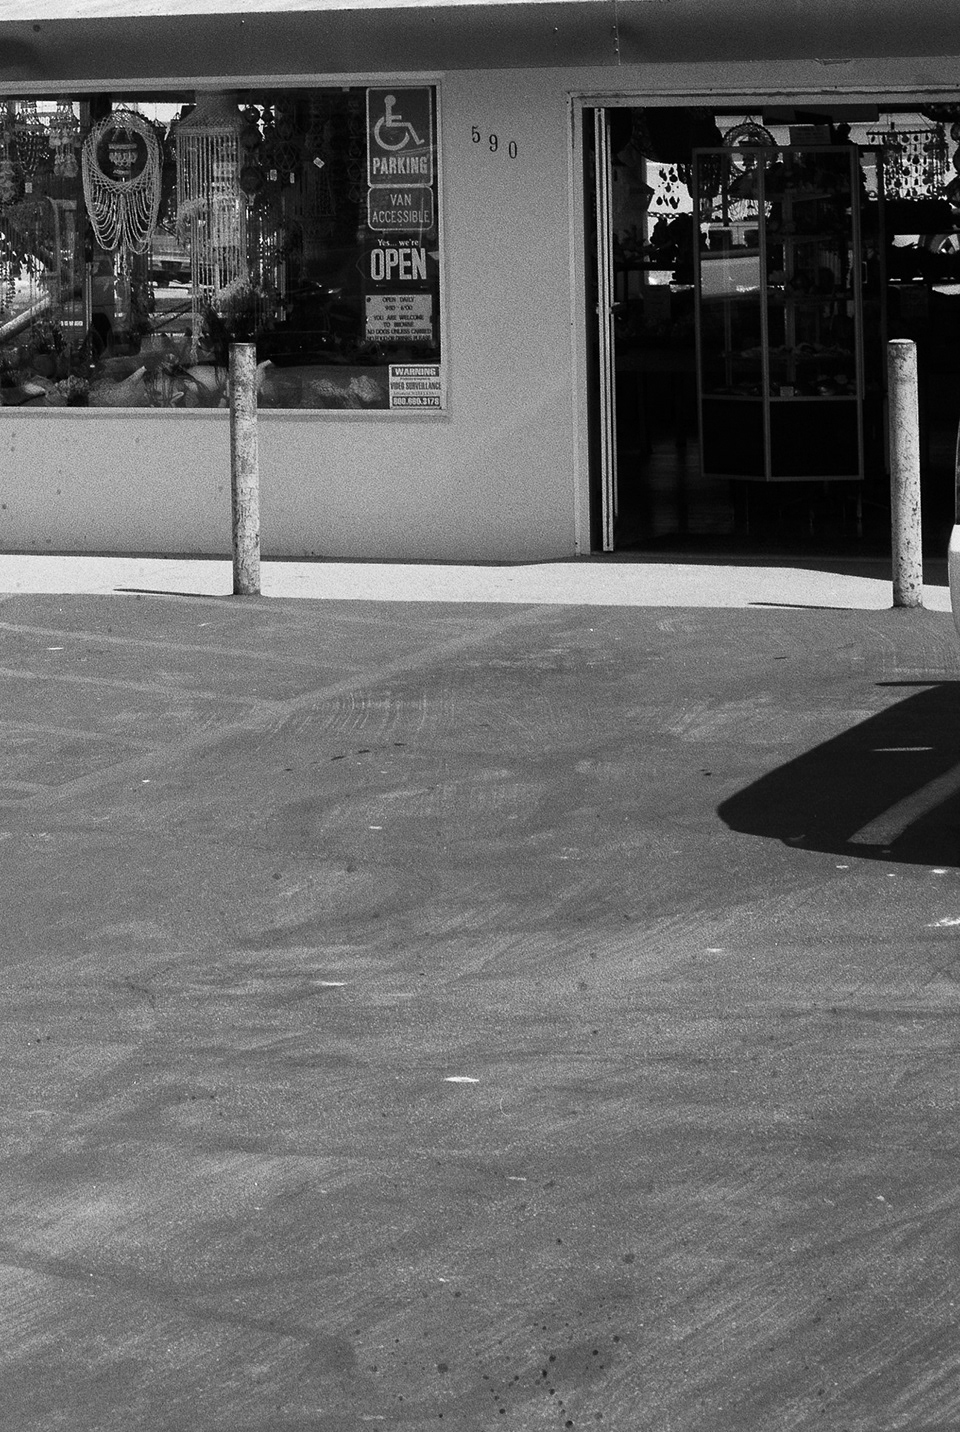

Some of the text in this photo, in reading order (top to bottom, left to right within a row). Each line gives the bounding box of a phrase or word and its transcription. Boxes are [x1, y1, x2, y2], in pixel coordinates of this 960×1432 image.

[471, 125, 517, 159] 590
[372, 156, 428, 174] PARKING
[390, 193, 412, 206] VAN
[372, 210, 430, 223] ACCESSIBLE
[398, 238, 419, 246] we're
[370, 248, 427, 281] OPEN
[394, 368, 437, 376] WARNING
[390, 381, 442, 390] VIDEO SURVEILLANCE
